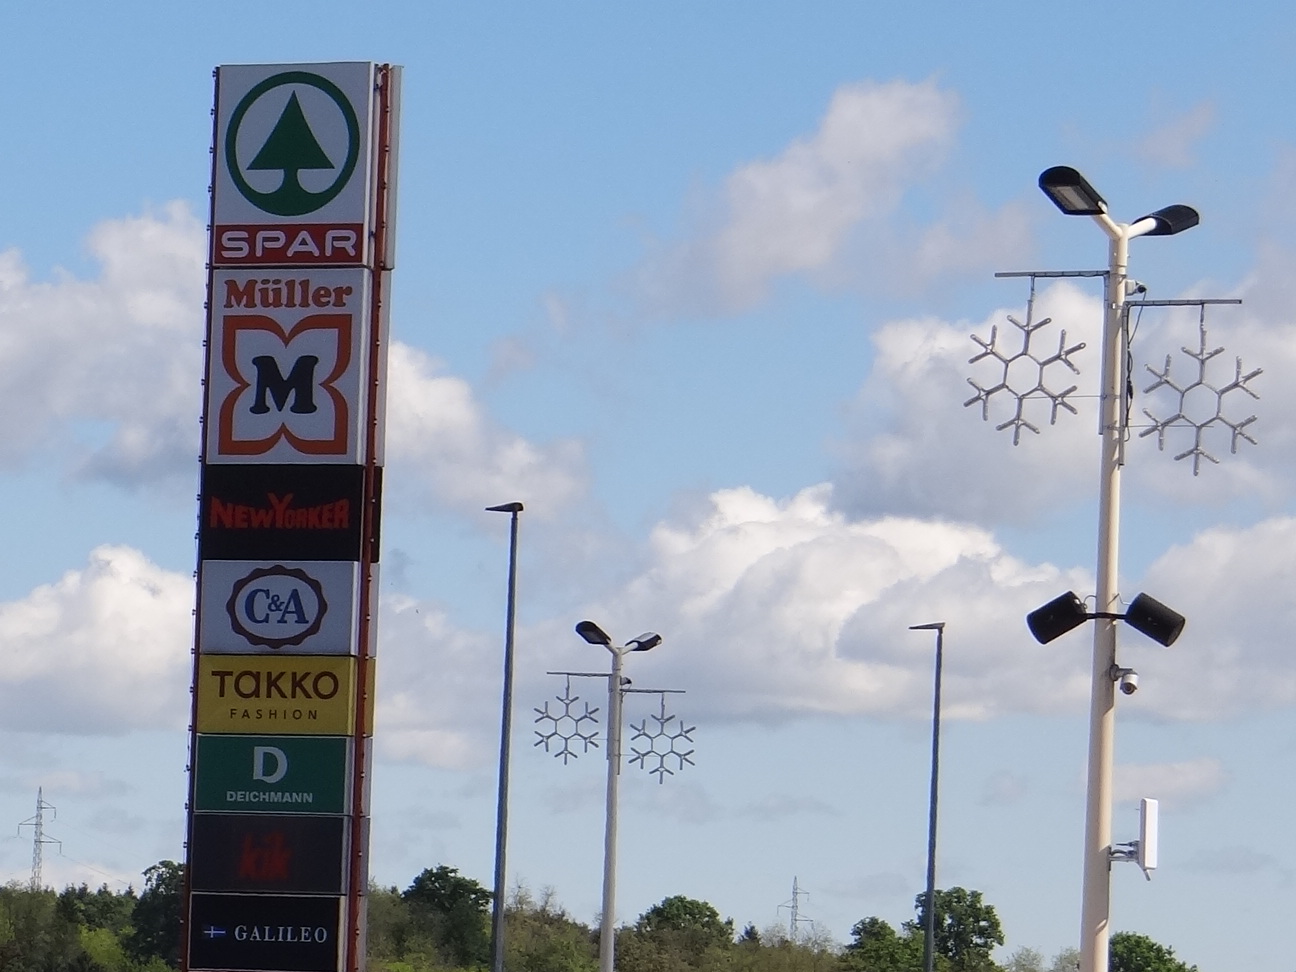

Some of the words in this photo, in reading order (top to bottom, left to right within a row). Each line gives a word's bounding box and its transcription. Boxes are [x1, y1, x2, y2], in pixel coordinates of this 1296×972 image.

[220, 230, 357, 258] SPAR
[223, 279, 354, 309] Müller
[249, 355, 320, 415] M
[244, 588, 310, 624] C&A
[230, 708, 318, 720] FASHION
[253, 746, 288, 784] D
[226, 790, 313, 804] DEICHMANN
[234, 924, 328, 944] GALILEO
